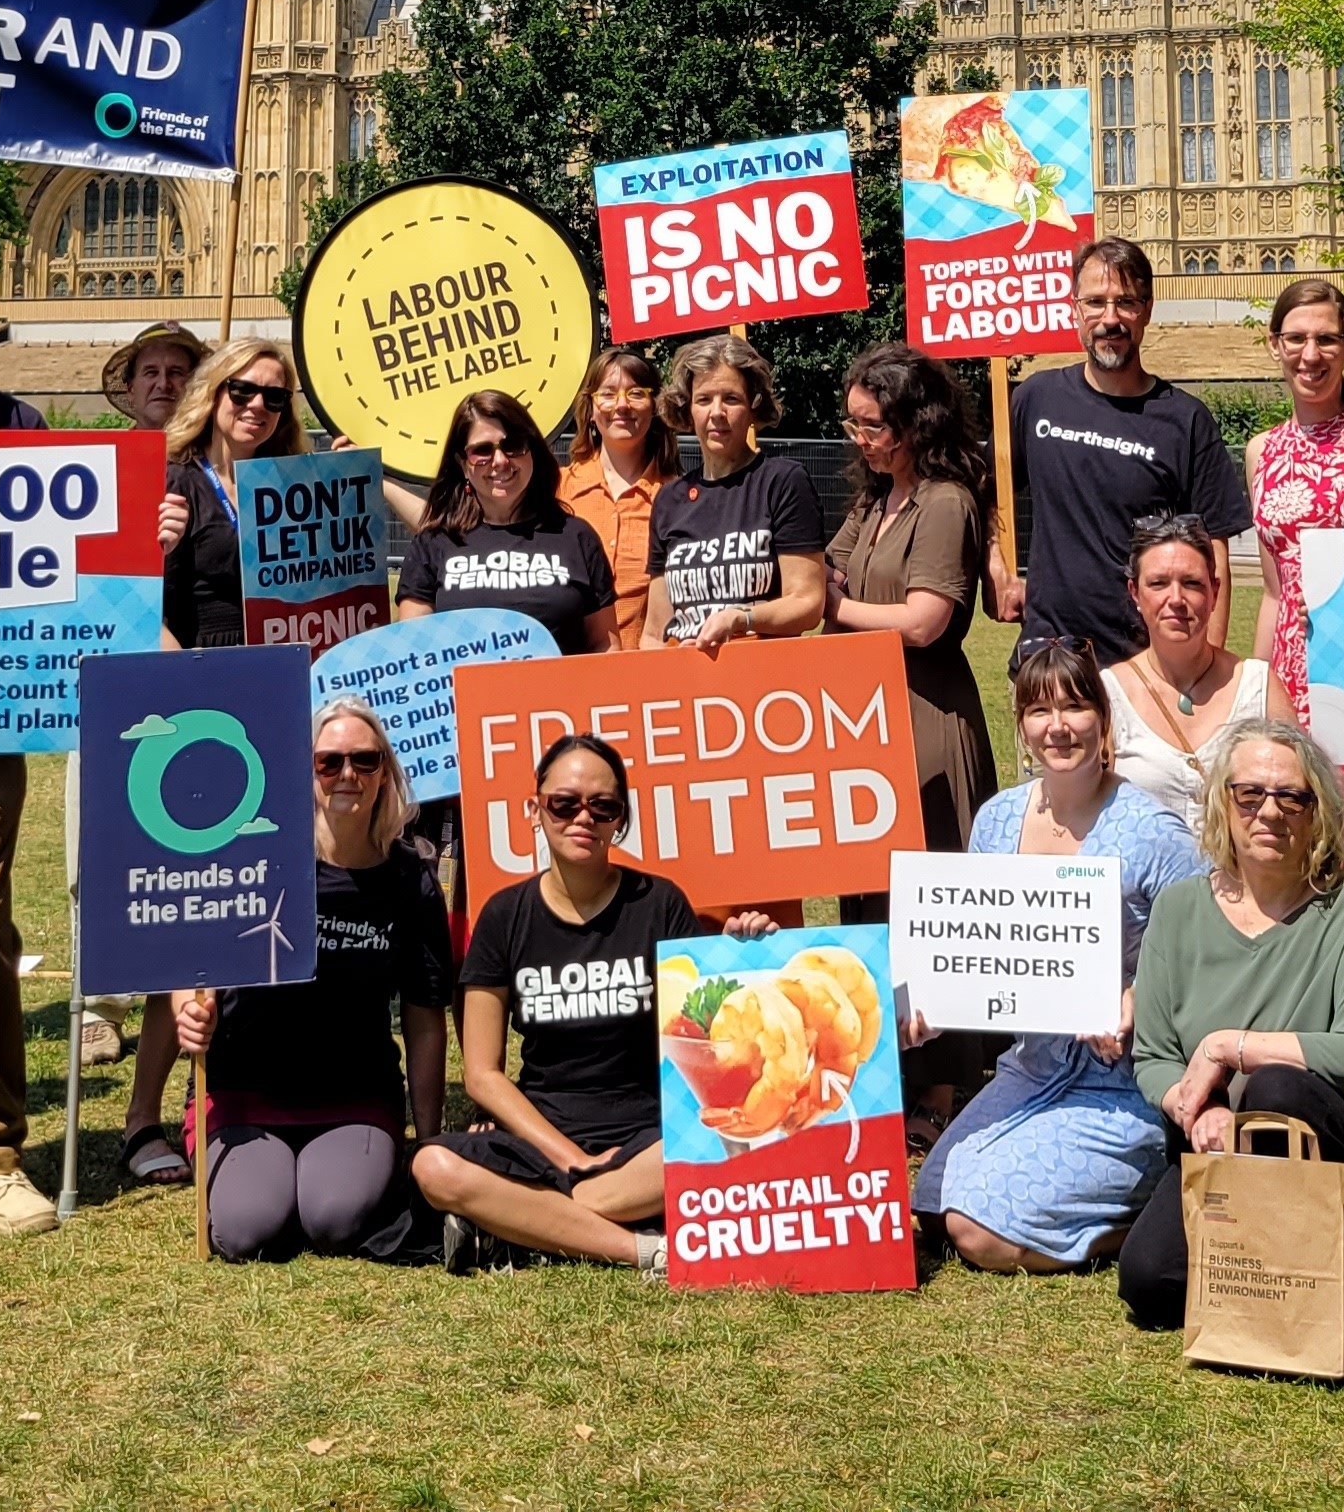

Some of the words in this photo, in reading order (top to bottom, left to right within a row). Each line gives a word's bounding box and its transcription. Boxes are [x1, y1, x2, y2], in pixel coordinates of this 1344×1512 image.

[34, 17, 182, 80] AND
[140, 122, 163, 135] the
[165, 124, 205, 140] Earth
[141, 107, 191, 125] Friends
[194, 116, 209, 127] of
[621, 148, 823, 197] EXPLOITATION
[624, 210, 701, 275] IS
[717, 192, 834, 261] NO
[920, 258, 1009, 282] TOPPED
[1015, 250, 1072, 271] WITH
[362, 262, 513, 331] LABOUR
[630, 251, 842, 323] PICNIC
[926, 271, 1070, 312] FORCED
[372, 300, 521, 371] BEHIND
[384, 364, 440, 400] THE
[445, 340, 532, 384] LABEL
[1050, 426, 1155, 461] earthsight
[254, 475, 371, 526] DON'T
[257, 523, 322, 563] LET
[330, 515, 374, 553] UK
[723, 530, 772, 561] END
[258, 552, 376, 587] COMPANIES
[445, 550, 568, 574] GLOBAL
[444, 569, 570, 591] FEMINIST
[710, 562, 773, 599] SLAVERY
[40, 625, 55, 640] a
[62, 624, 116, 640] new
[264, 603, 377, 647] PICNIC
[35, 648, 83, 670] and
[317, 675, 325, 693] I
[330, 653, 420, 690] support
[424, 652, 438, 667] a
[441, 638, 487, 663] new
[491, 629, 529, 651] law
[129, 863, 233, 892] Friends
[239, 859, 268, 884] of
[1056, 866, 1105, 878] @PBIUK
[127, 899, 178, 924] the
[184, 892, 266, 920] Earth
[918, 887, 923, 903] I
[931, 887, 1014, 907] STAND
[1022, 889, 1091, 909] WITH
[316, 914, 376, 936] Friends
[909, 920, 1001, 940] HUMAN
[1010, 924, 1100, 944] RIGHTS
[516, 956, 652, 996] GLOBAL
[933, 955, 1074, 977] DEFENDERS
[520, 985, 653, 1024] FEMINIST
[988, 992, 1016, 1020] pbi
[678, 1176, 842, 1218] COCKTAIL
[848, 1170, 890, 1200] OF
[675, 1201, 904, 1262] CRUELTY!
[1209, 1239, 1238, 1250] Support
[1209, 1255, 1265, 1272] BUSINESS,
[1209, 1269, 1247, 1282] HUMAN
[1251, 1274, 1292, 1287] RIGHTS
[1295, 1279, 1315, 1289] and
[1209, 1283, 1288, 1301] ENVIRONMENT
